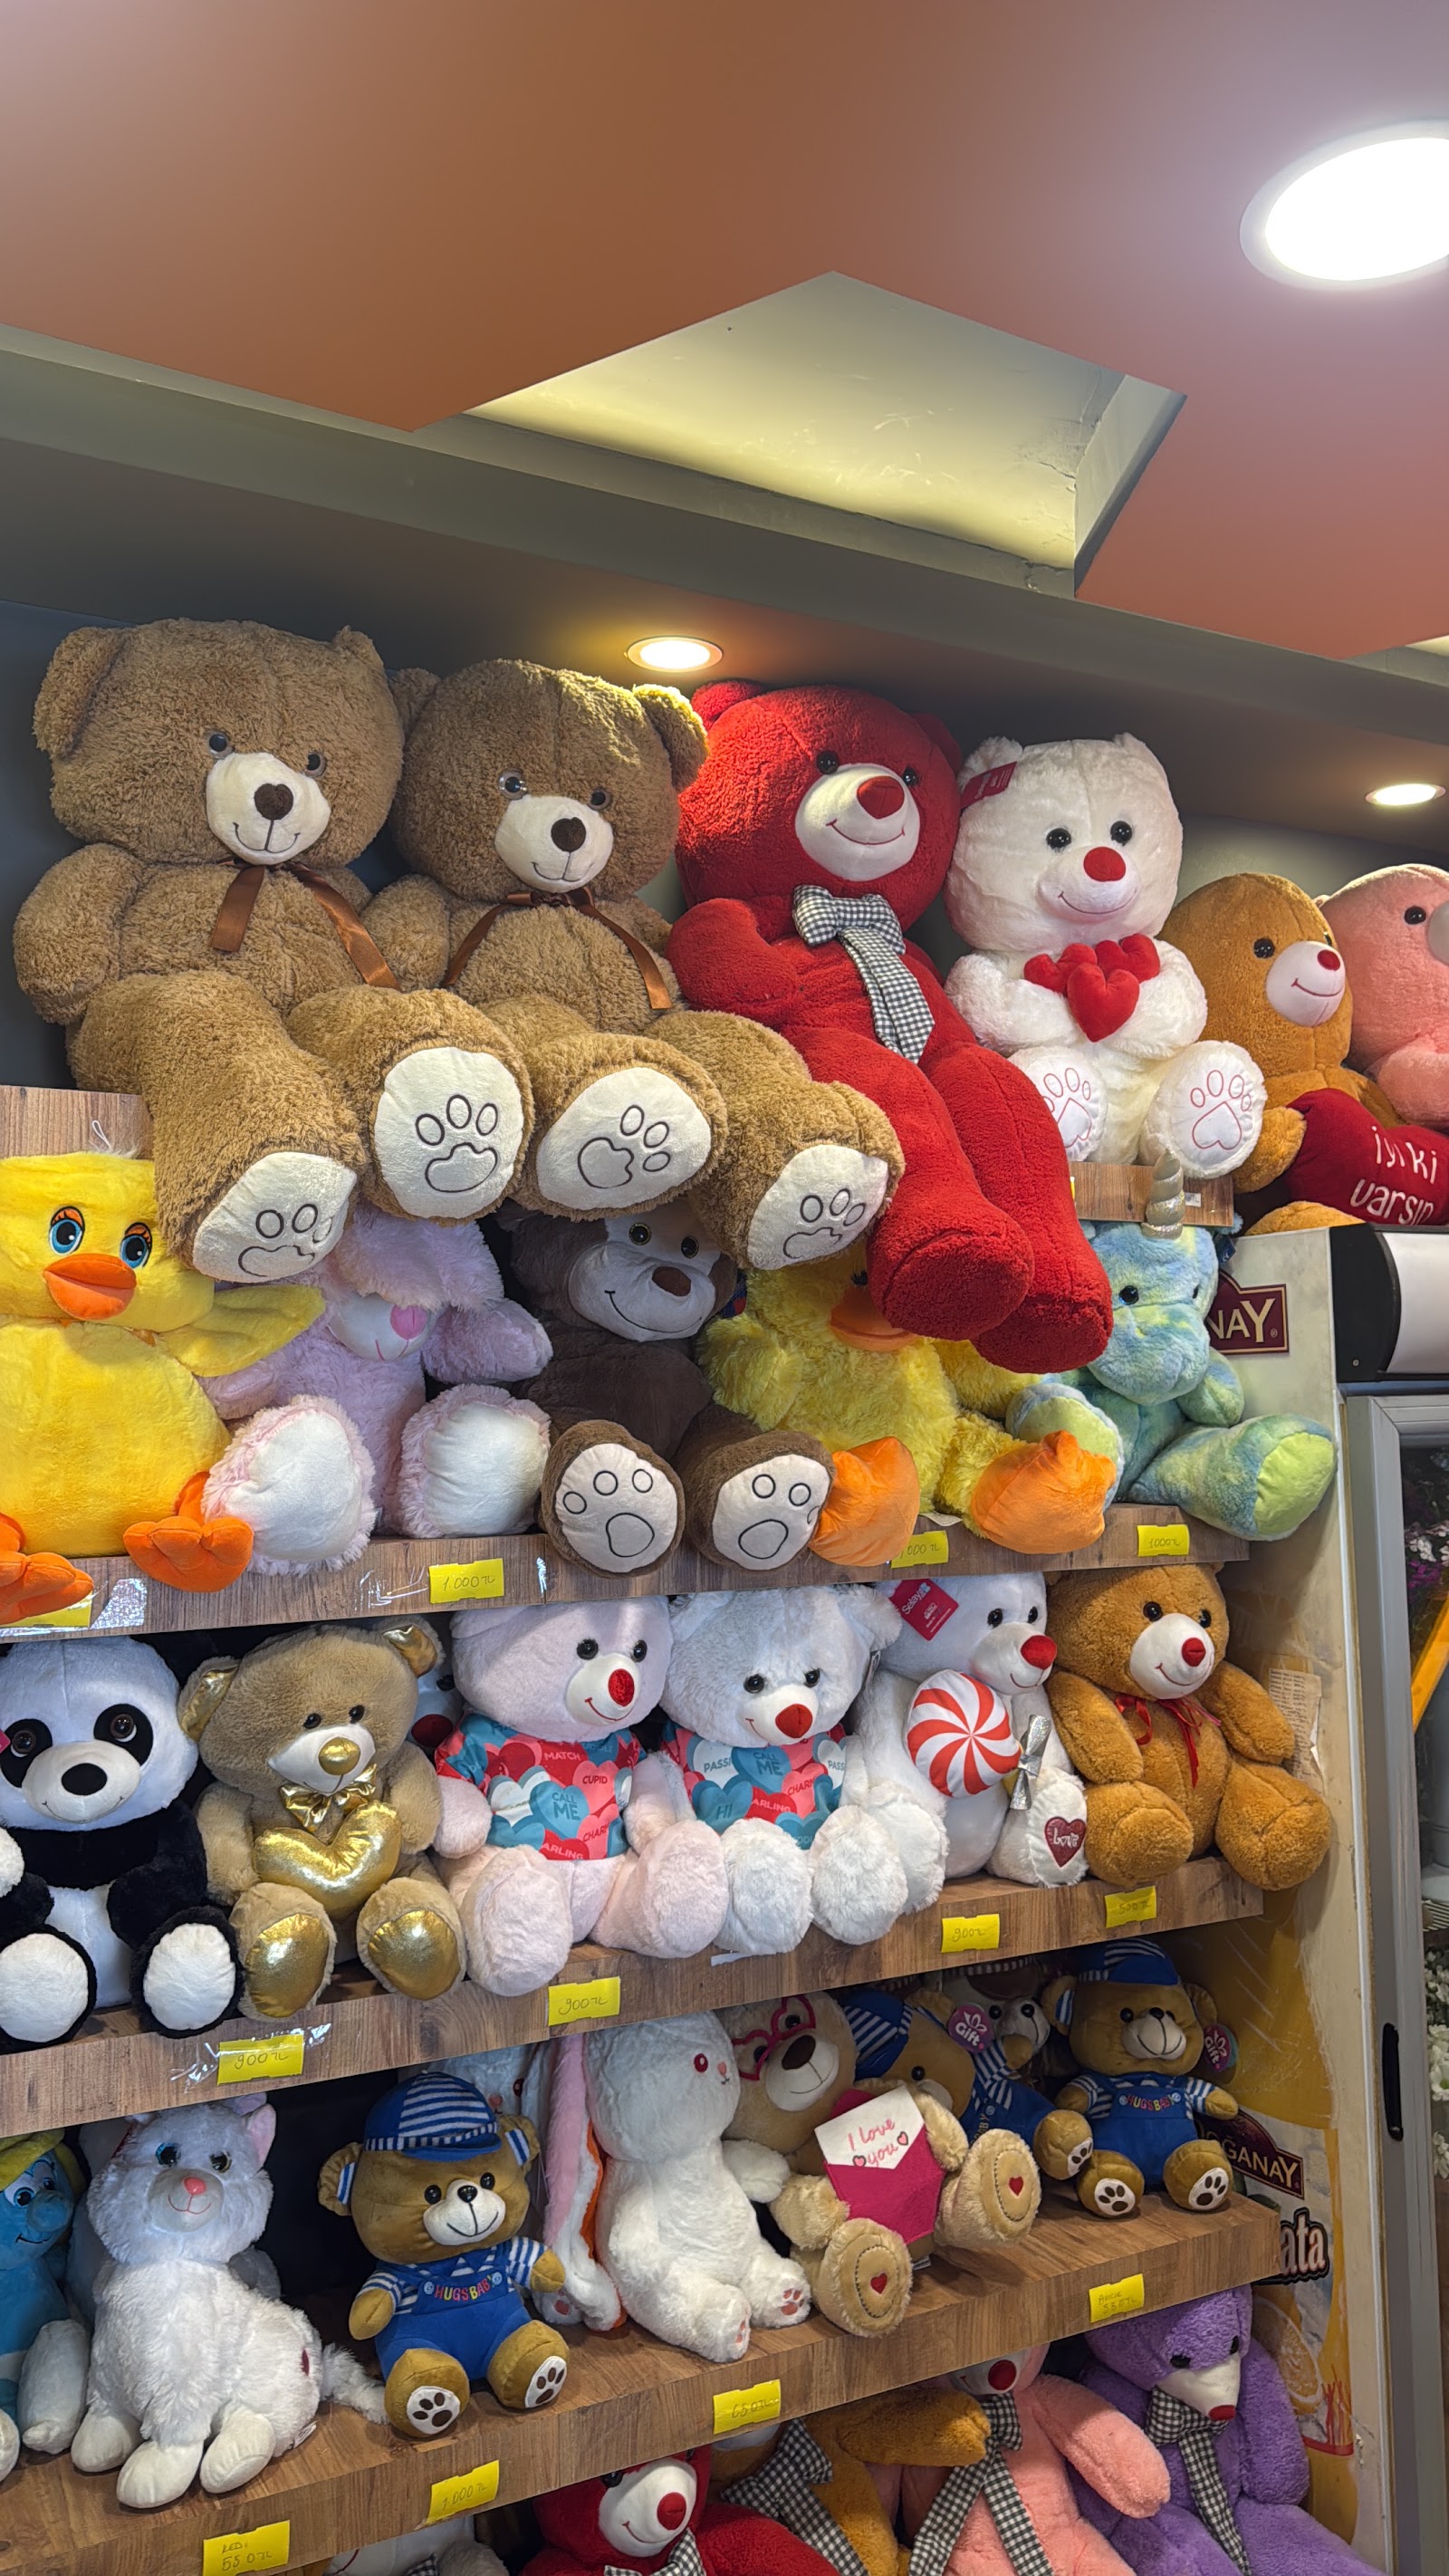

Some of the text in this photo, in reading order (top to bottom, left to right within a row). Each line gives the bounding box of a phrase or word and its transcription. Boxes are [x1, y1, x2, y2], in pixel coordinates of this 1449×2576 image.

[544, 1751, 581, 1762] MATCH
[753, 1751, 778, 1762] CALL
[757, 1760, 783, 1776] ME
[582, 1774, 608, 1784] CUPID
[552, 1792, 577, 1804] CALL
[553, 1802, 581, 1821] ME
[716, 1803, 733, 1820] HI
[955, 2022, 980, 2047] Gift
[1204, 2035, 1220, 2064] Gift
[848, 2132, 856, 2152] I
